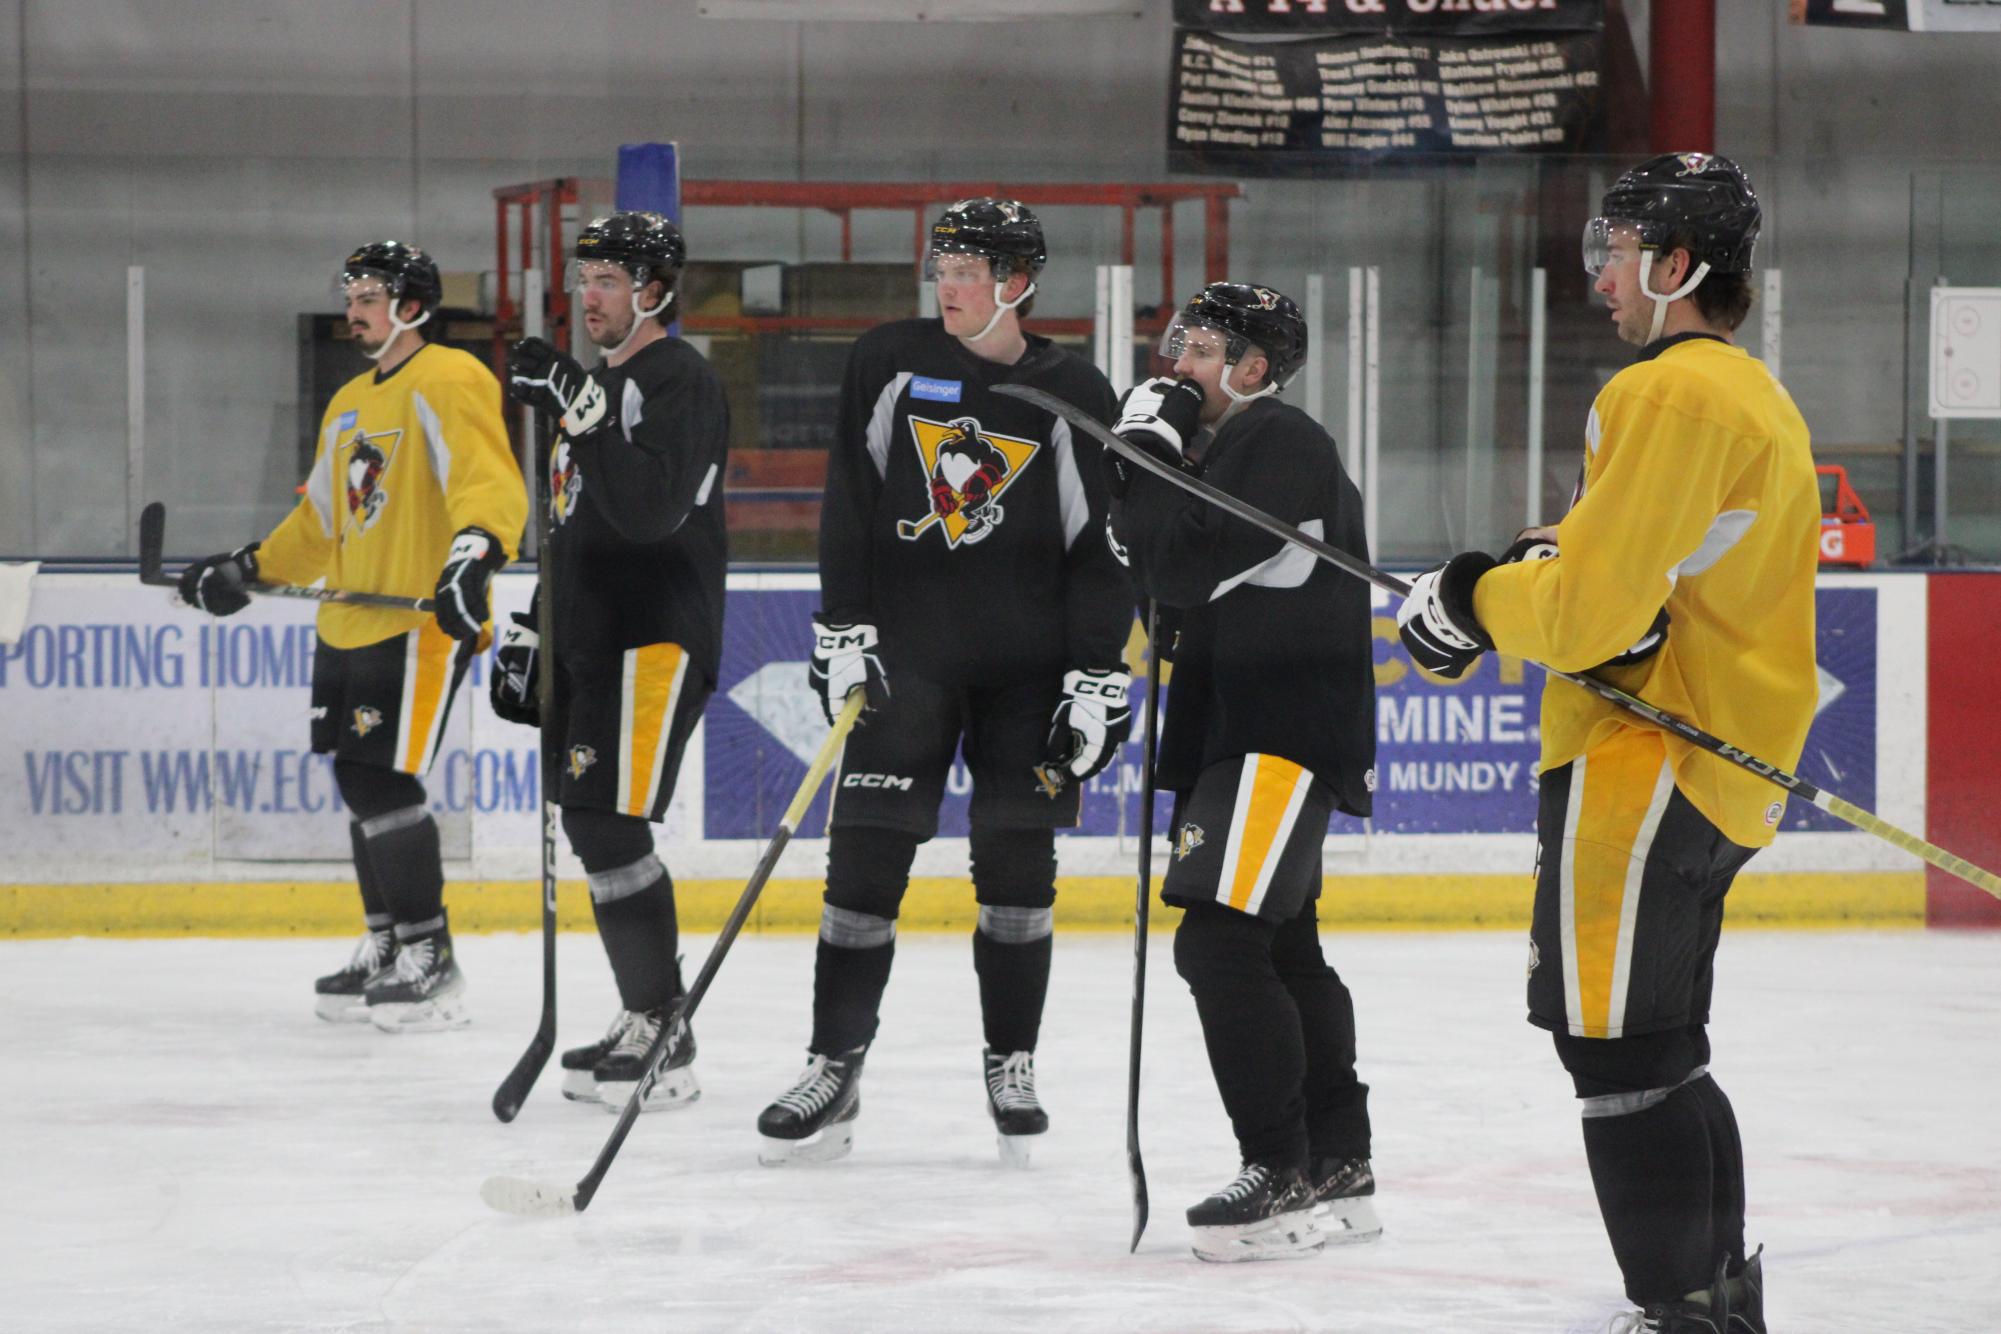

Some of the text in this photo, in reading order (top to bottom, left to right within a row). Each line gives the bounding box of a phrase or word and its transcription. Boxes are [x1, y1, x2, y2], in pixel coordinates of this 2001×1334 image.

[912, 380, 961, 397] Geisinger
[1821, 529, 1844, 558] G
[24, 750, 129, 815] VISIT
[843, 773, 913, 791] CCM
[1390, 762, 1519, 791] MUNDY
